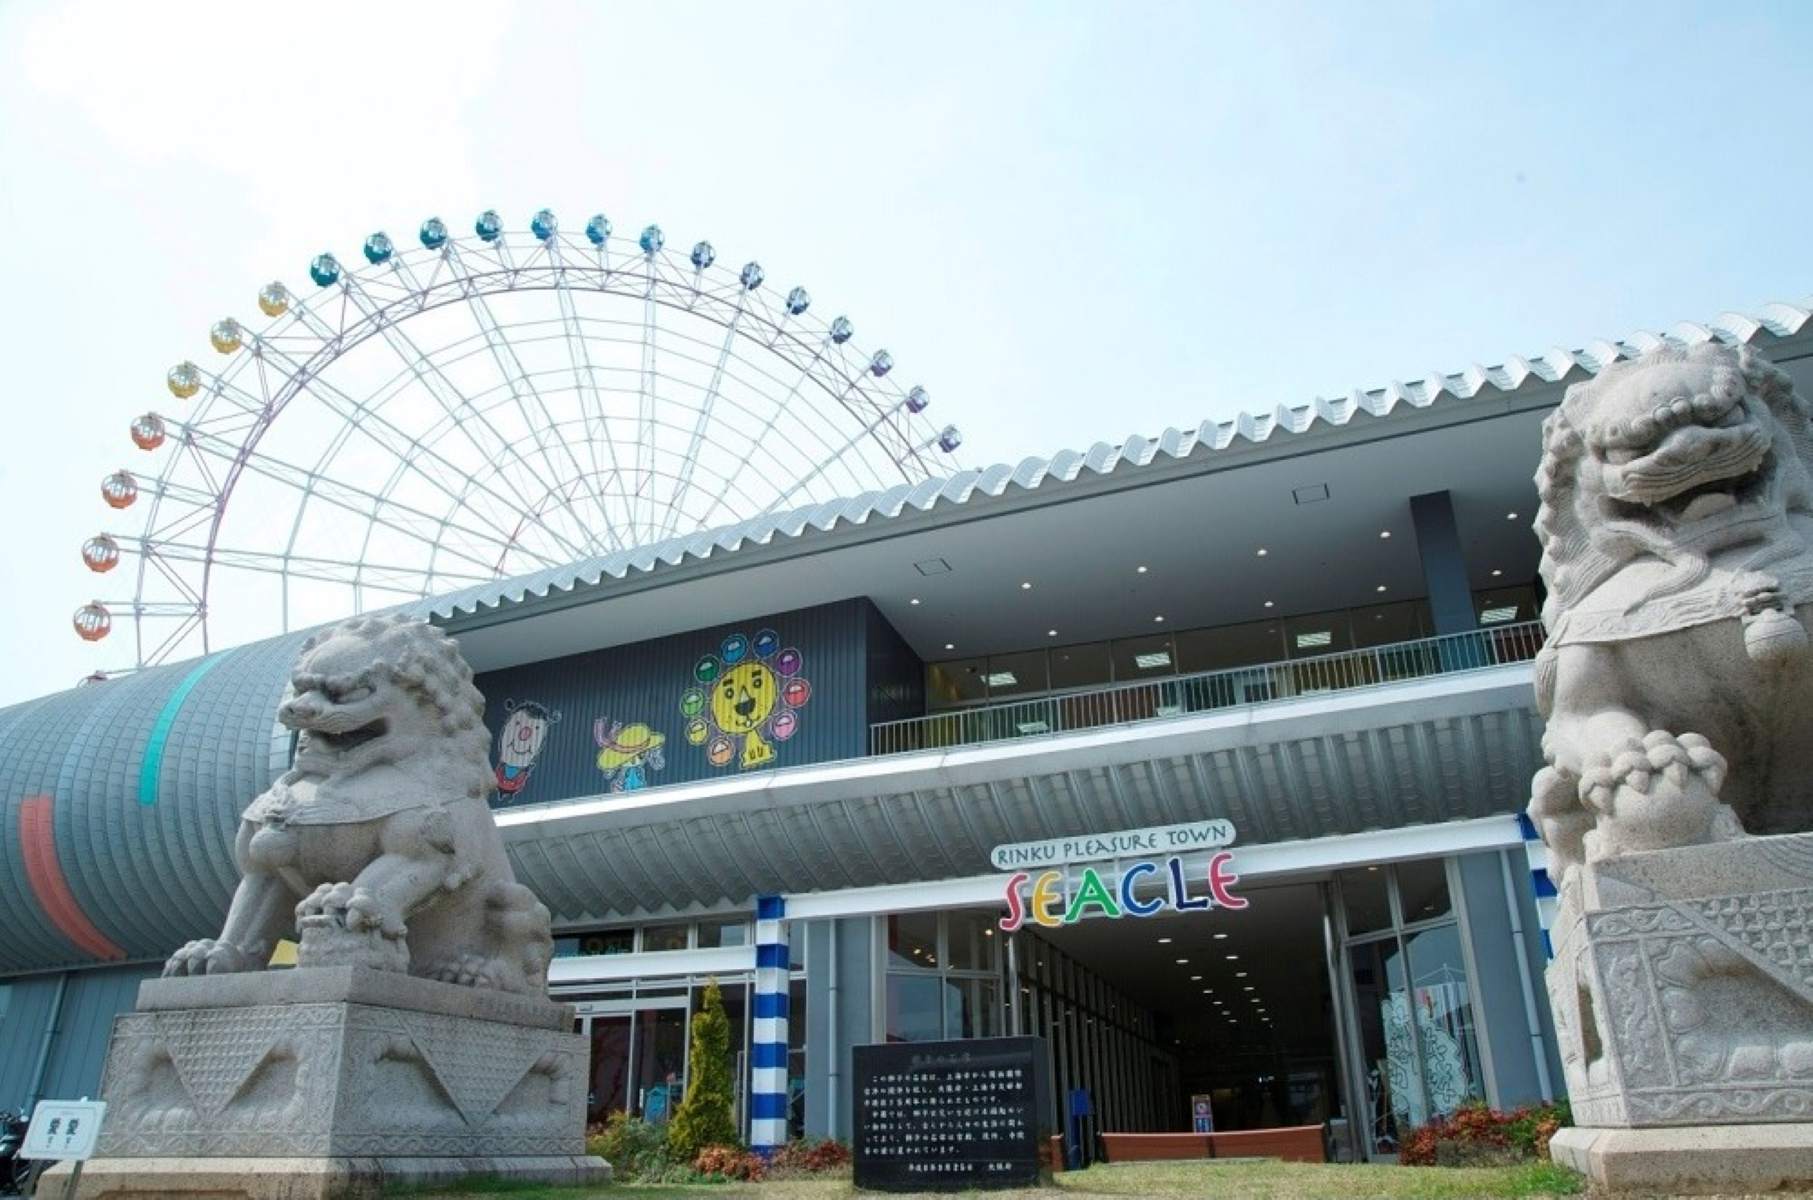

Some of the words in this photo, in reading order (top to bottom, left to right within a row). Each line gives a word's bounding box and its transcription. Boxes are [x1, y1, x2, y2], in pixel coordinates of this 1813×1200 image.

[997, 844, 1056, 865] RINKU
[1064, 833, 1158, 859] PLEASURE
[1167, 825, 1227, 846] TOWN
[1000, 852, 1249, 931] SEACLE
